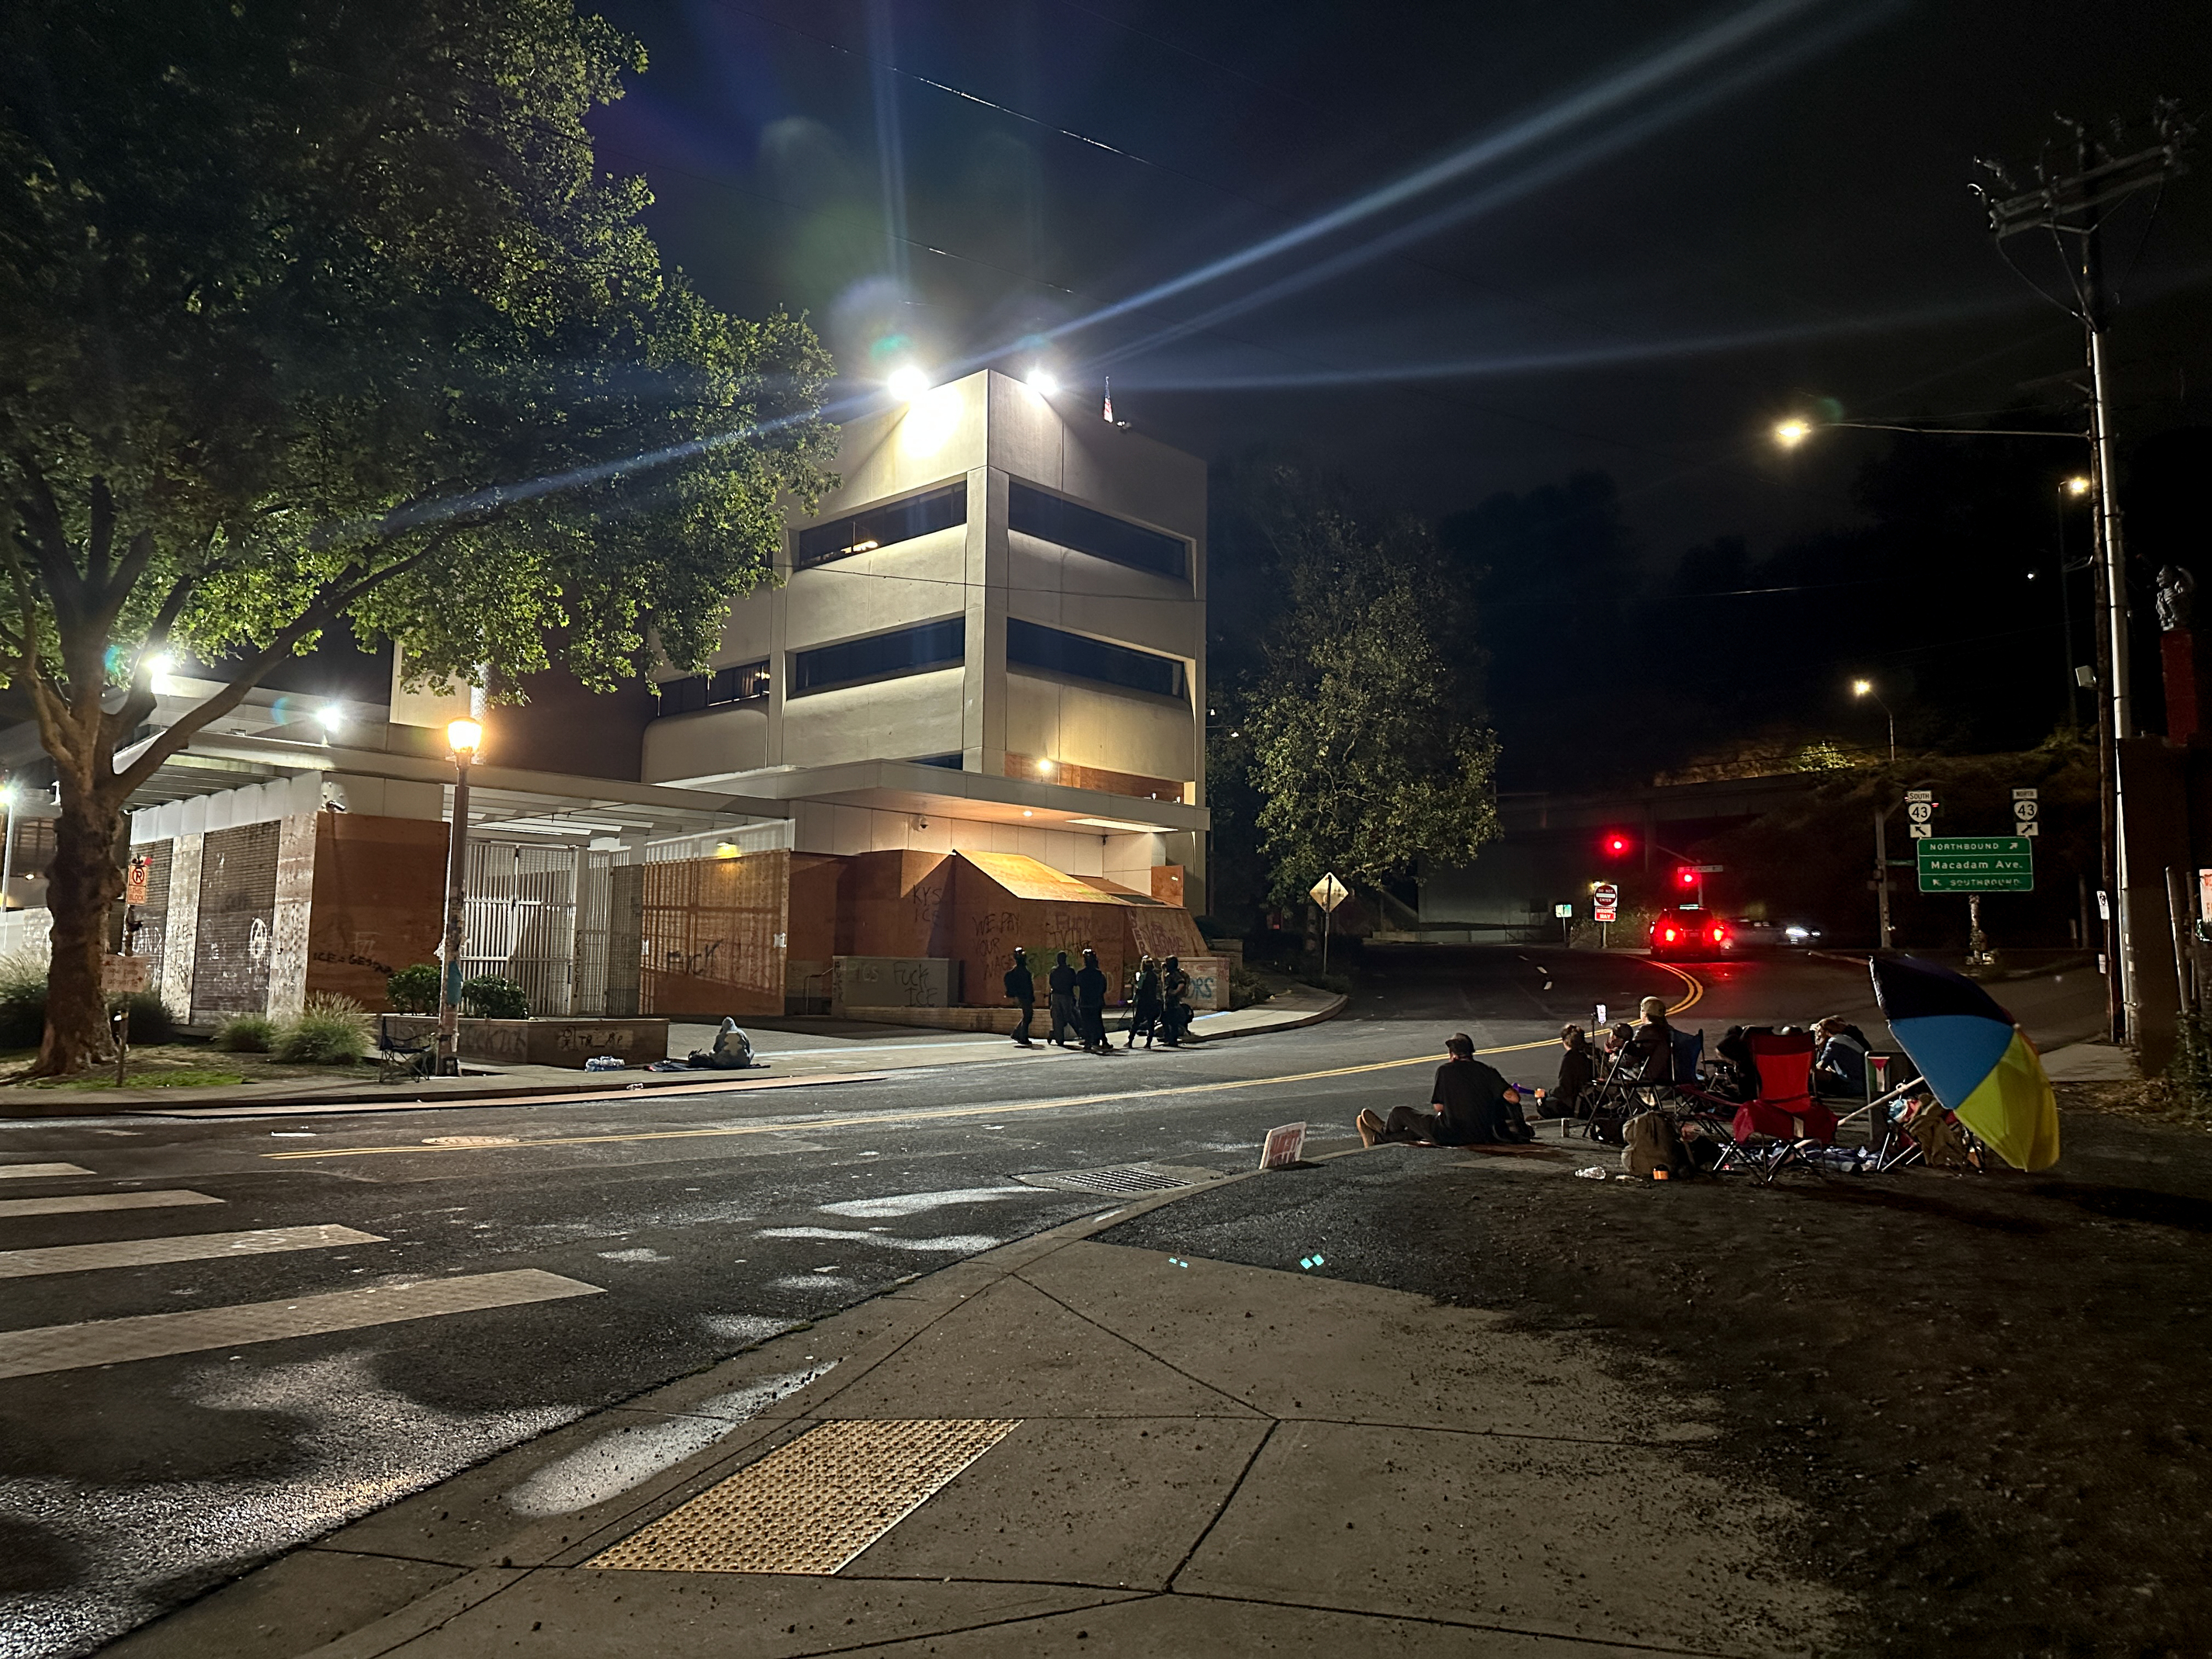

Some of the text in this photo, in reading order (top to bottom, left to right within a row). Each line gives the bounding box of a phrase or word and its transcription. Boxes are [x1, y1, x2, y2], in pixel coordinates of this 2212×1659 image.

[1912, 806, 1928, 819] 43
[2017, 804, 2035, 816] 43
[1931, 861, 1988, 870] Macadam
[972, 911, 1021, 937] WE PAY
[313, 951, 338, 963] ICE
[904, 986, 938, 1008] ICE
